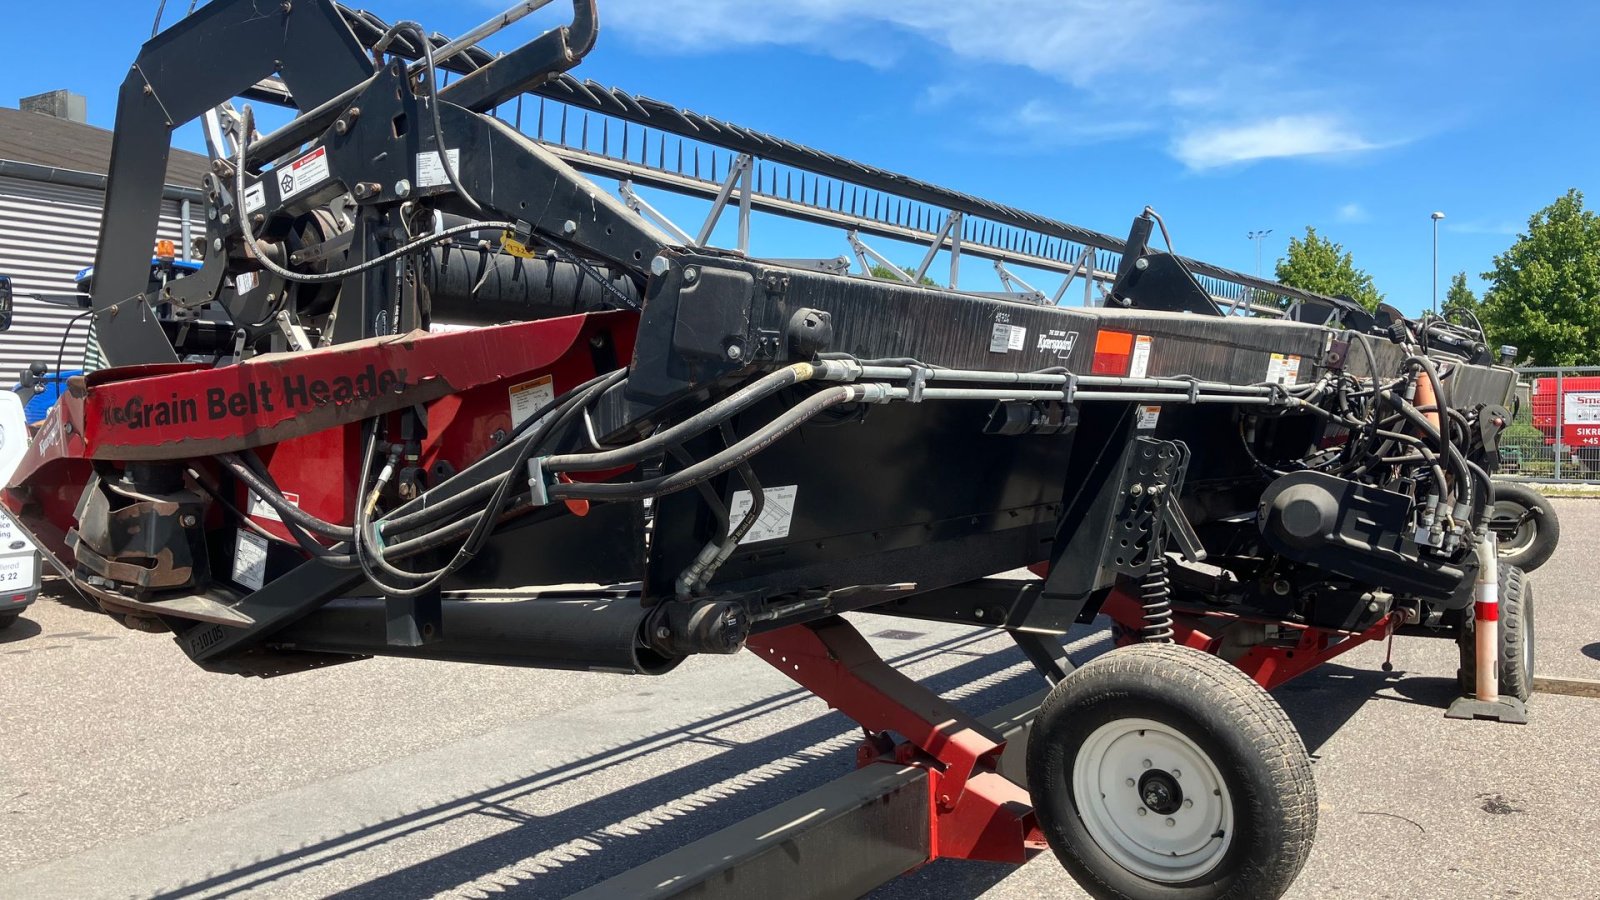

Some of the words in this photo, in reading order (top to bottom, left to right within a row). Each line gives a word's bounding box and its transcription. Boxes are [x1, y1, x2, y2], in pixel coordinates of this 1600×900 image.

[124, 392, 198, 430] Grain
[206, 381, 274, 420] Belt
[283, 364, 409, 408] Header
[7, 571, 18, 580] 22
[191, 624, 224, 653] F-10105
